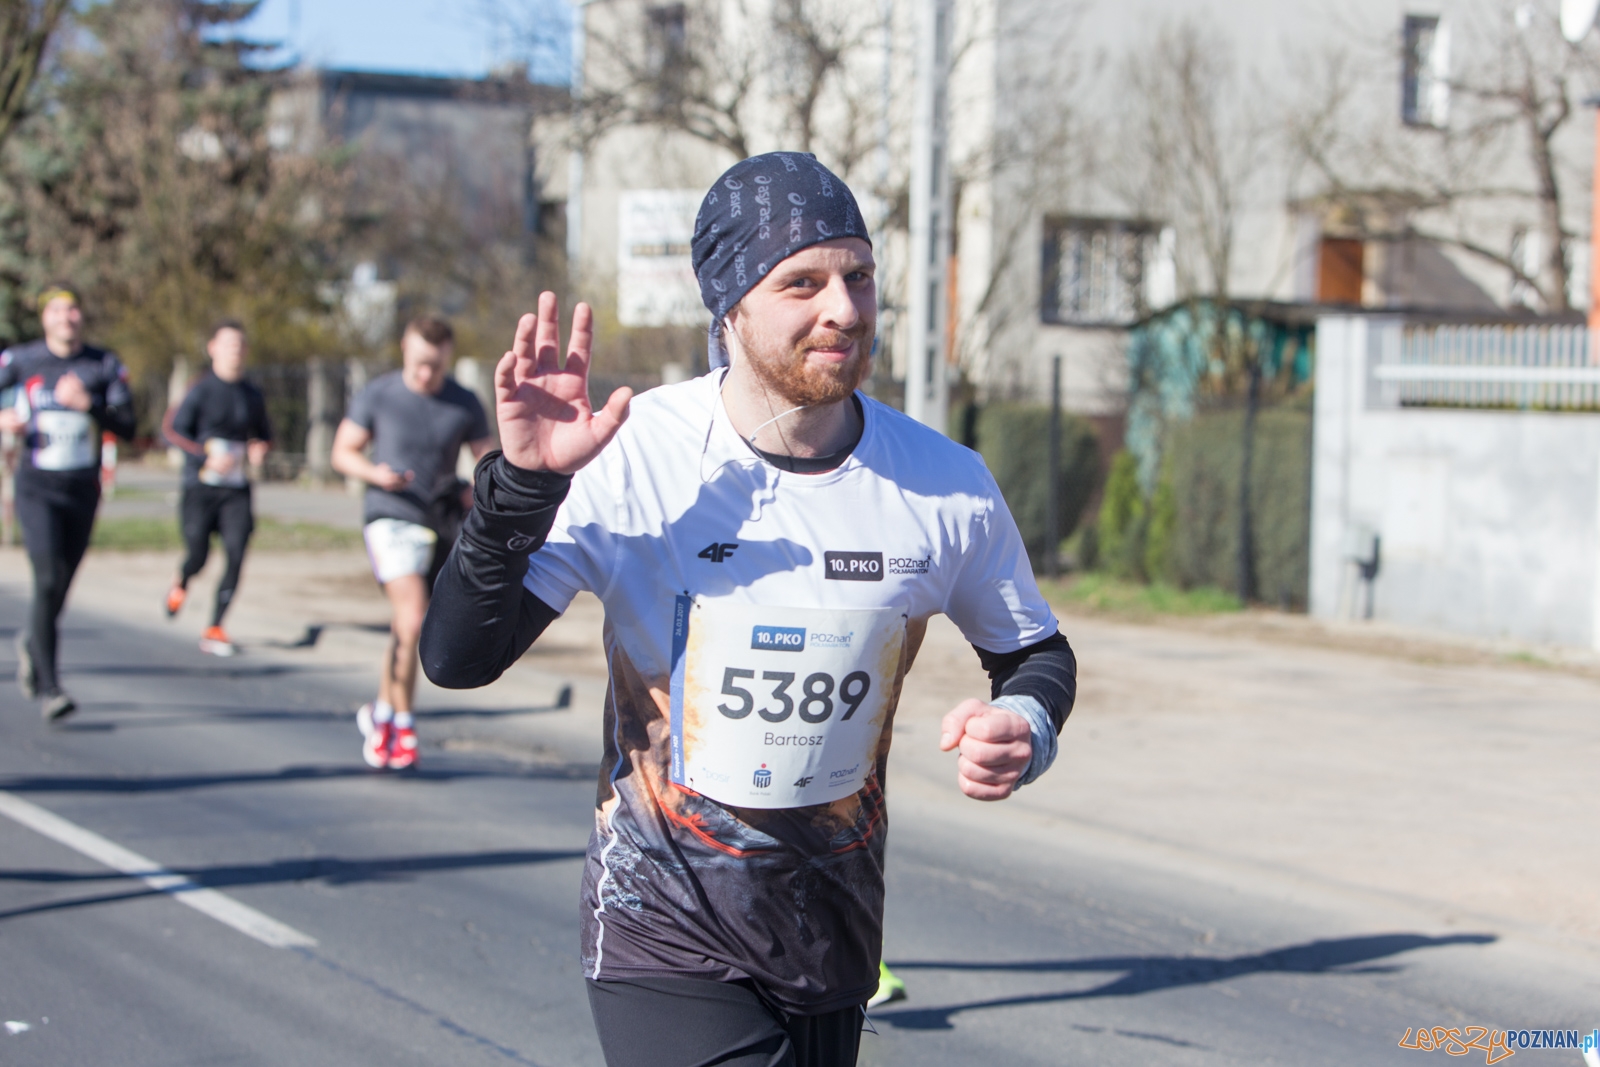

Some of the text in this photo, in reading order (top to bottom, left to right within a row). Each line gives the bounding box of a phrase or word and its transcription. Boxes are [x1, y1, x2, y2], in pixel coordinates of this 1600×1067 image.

[759, 207, 771, 240] asics
[789, 207, 803, 243] asics
[734, 254, 747, 287] asics
[697, 542, 739, 563] 4F
[829, 558, 880, 574] 10. PKO
[756, 632, 802, 646] 10. PKO
[716, 666, 871, 724] 5389
[763, 732, 824, 747] Bartosz
[793, 776, 814, 788] 4F
